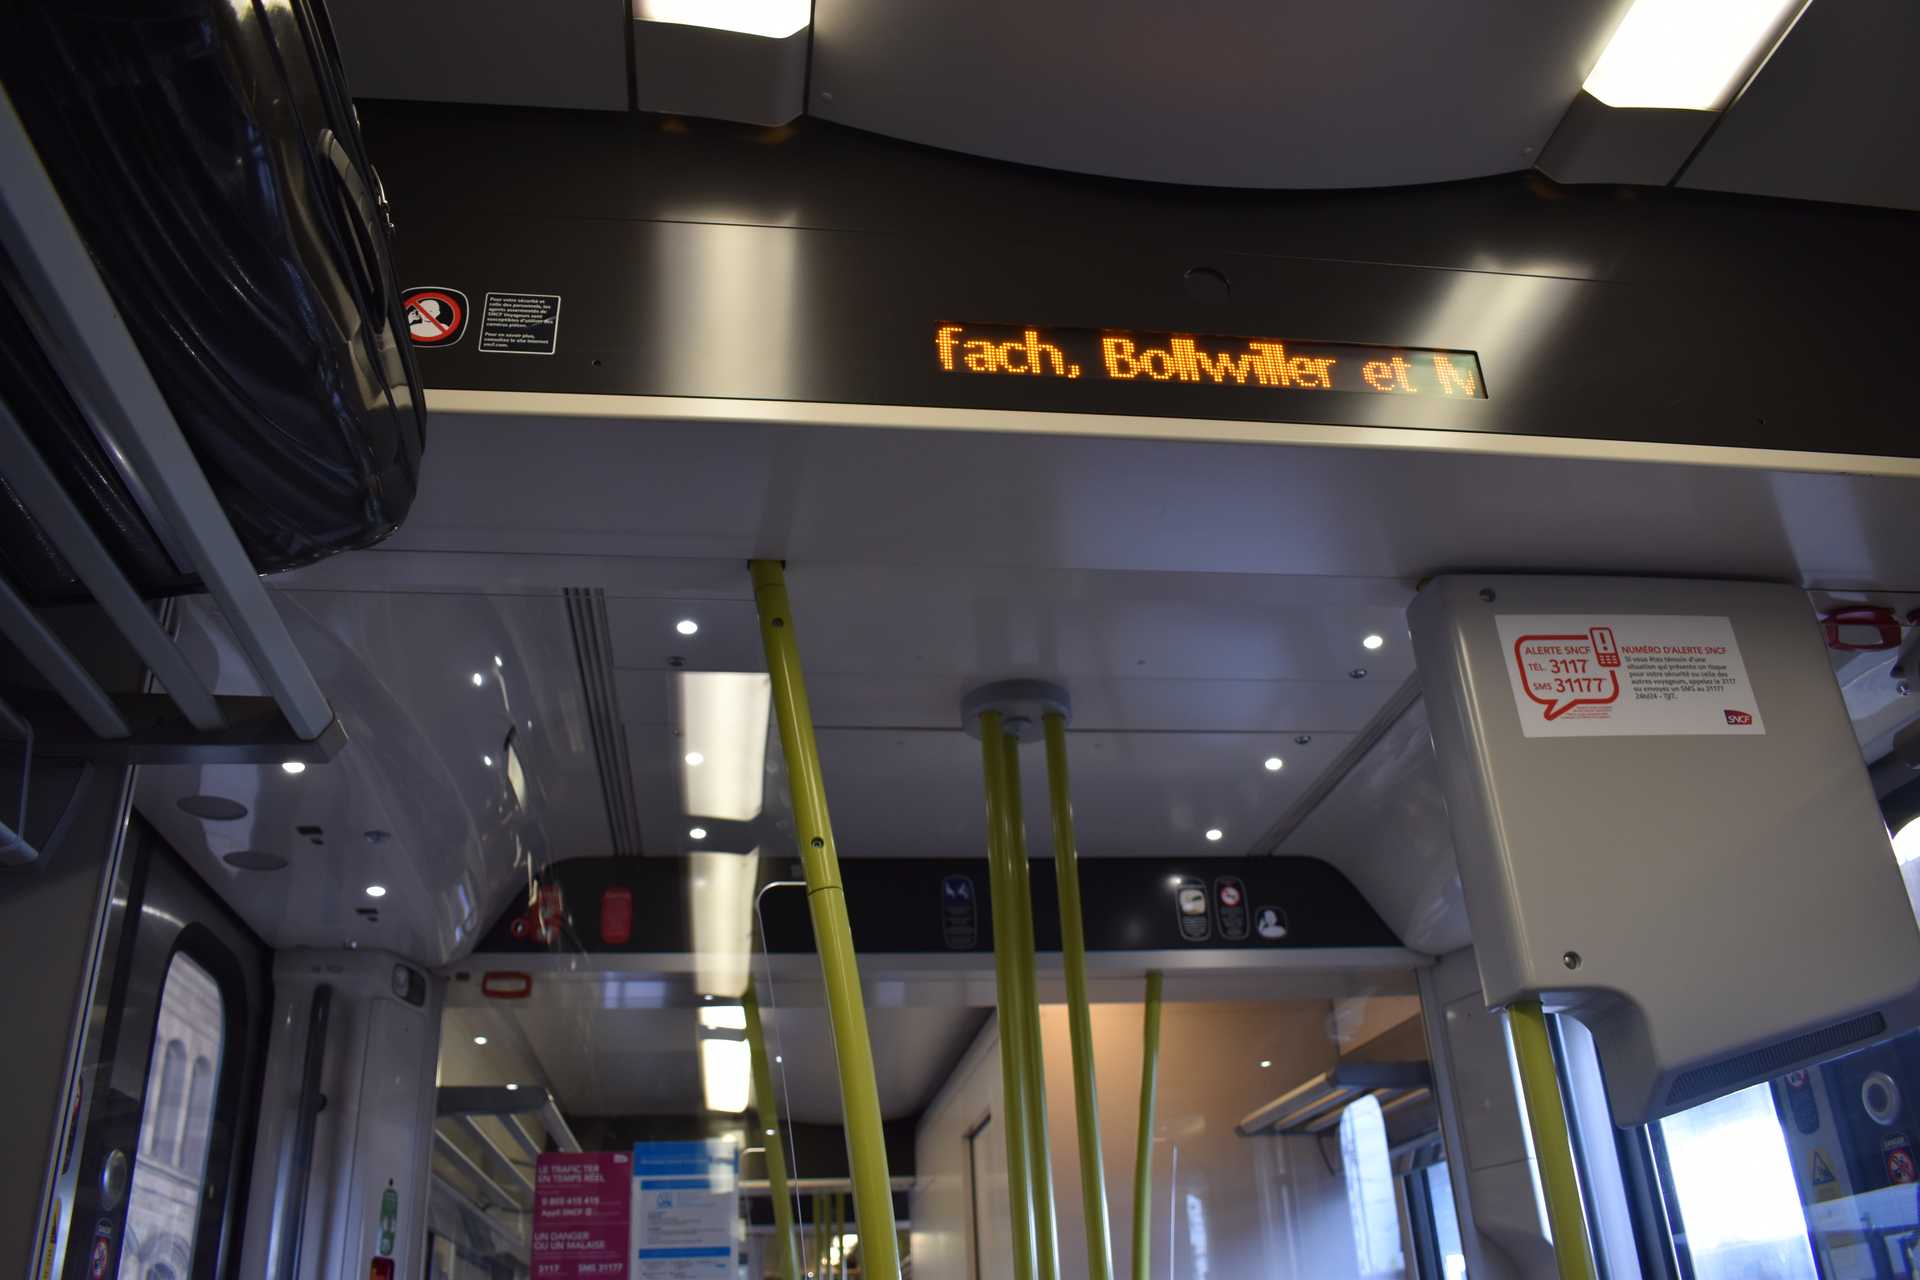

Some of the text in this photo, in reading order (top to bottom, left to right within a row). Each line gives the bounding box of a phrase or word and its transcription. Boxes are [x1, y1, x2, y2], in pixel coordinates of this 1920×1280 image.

[935, 326, 1080, 379] fach,
[1102, 338, 1336, 388] Bollwiller
[1362, 357, 1417, 391] et
[1525, 647, 1591, 655] ALERTE SNCF
[1549, 659, 1588, 673] 3117
[1533, 678, 1606, 692] SMS 31177
[1727, 715, 1751, 723] SNCF
